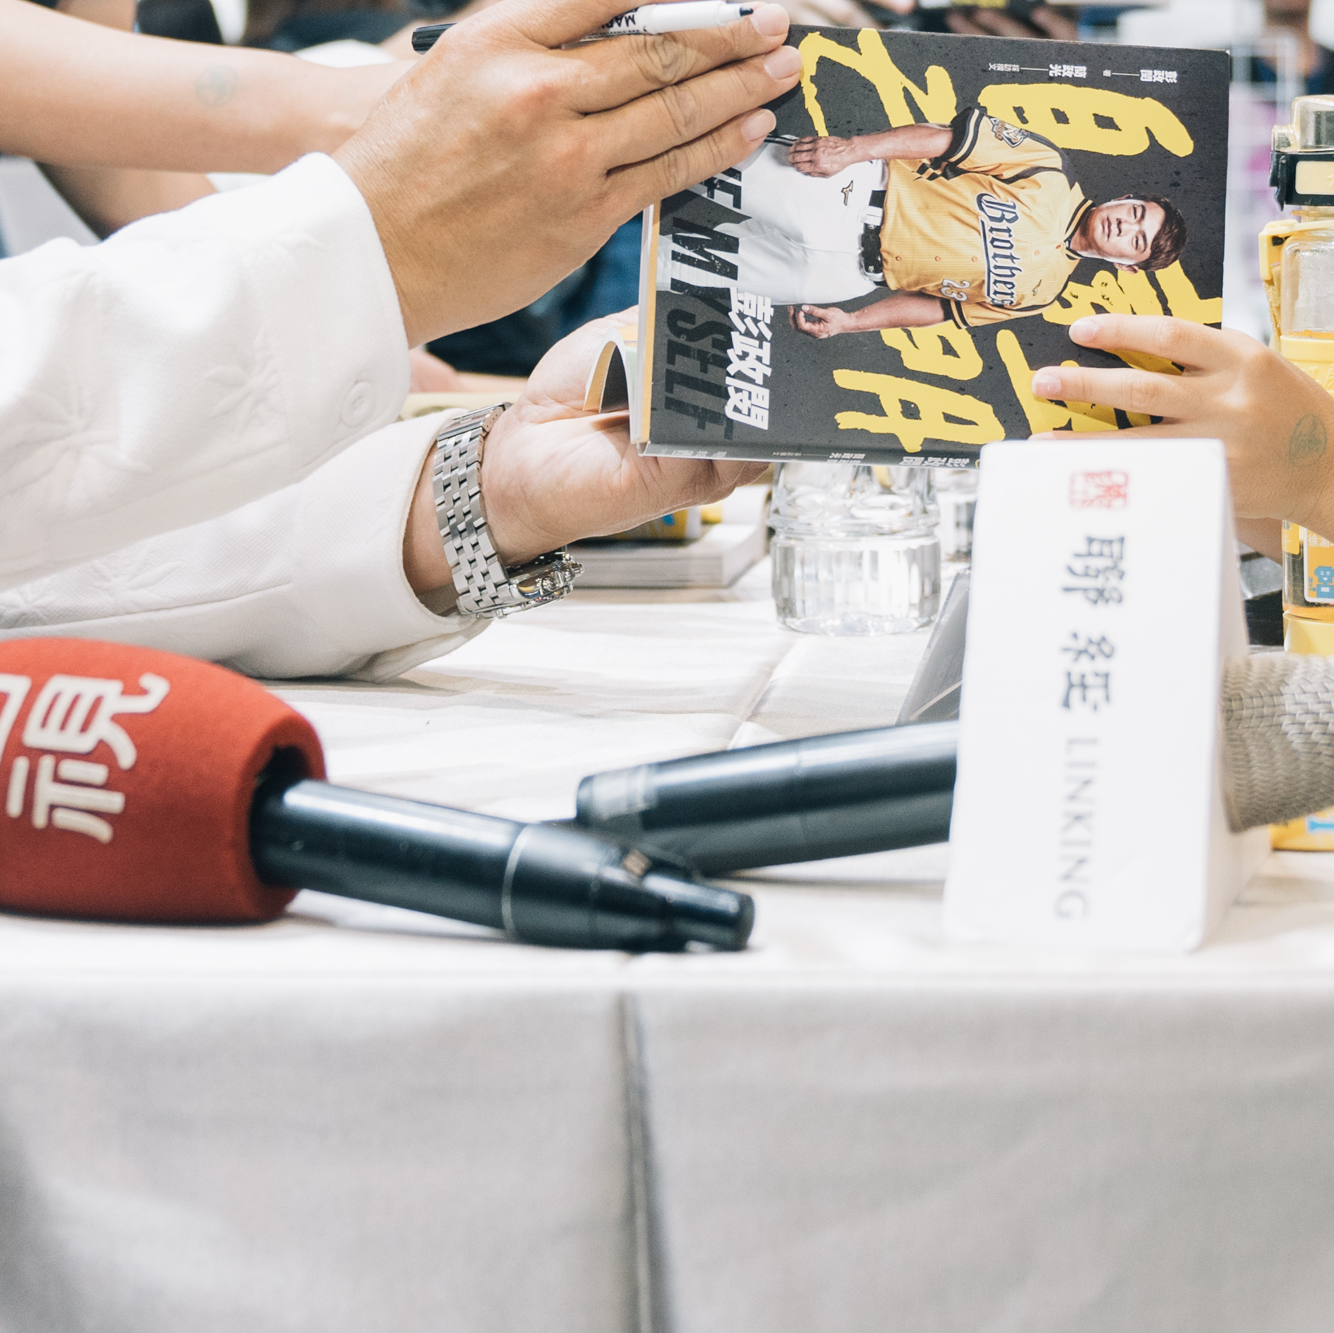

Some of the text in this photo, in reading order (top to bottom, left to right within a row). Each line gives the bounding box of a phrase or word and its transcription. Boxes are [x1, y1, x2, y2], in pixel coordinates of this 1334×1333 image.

[940, 278, 971, 302] 23
[976, 192, 1023, 306] Brothers
[724, 286, 774, 431] 彭政閔
[1053, 736, 1100, 921] LINKING
